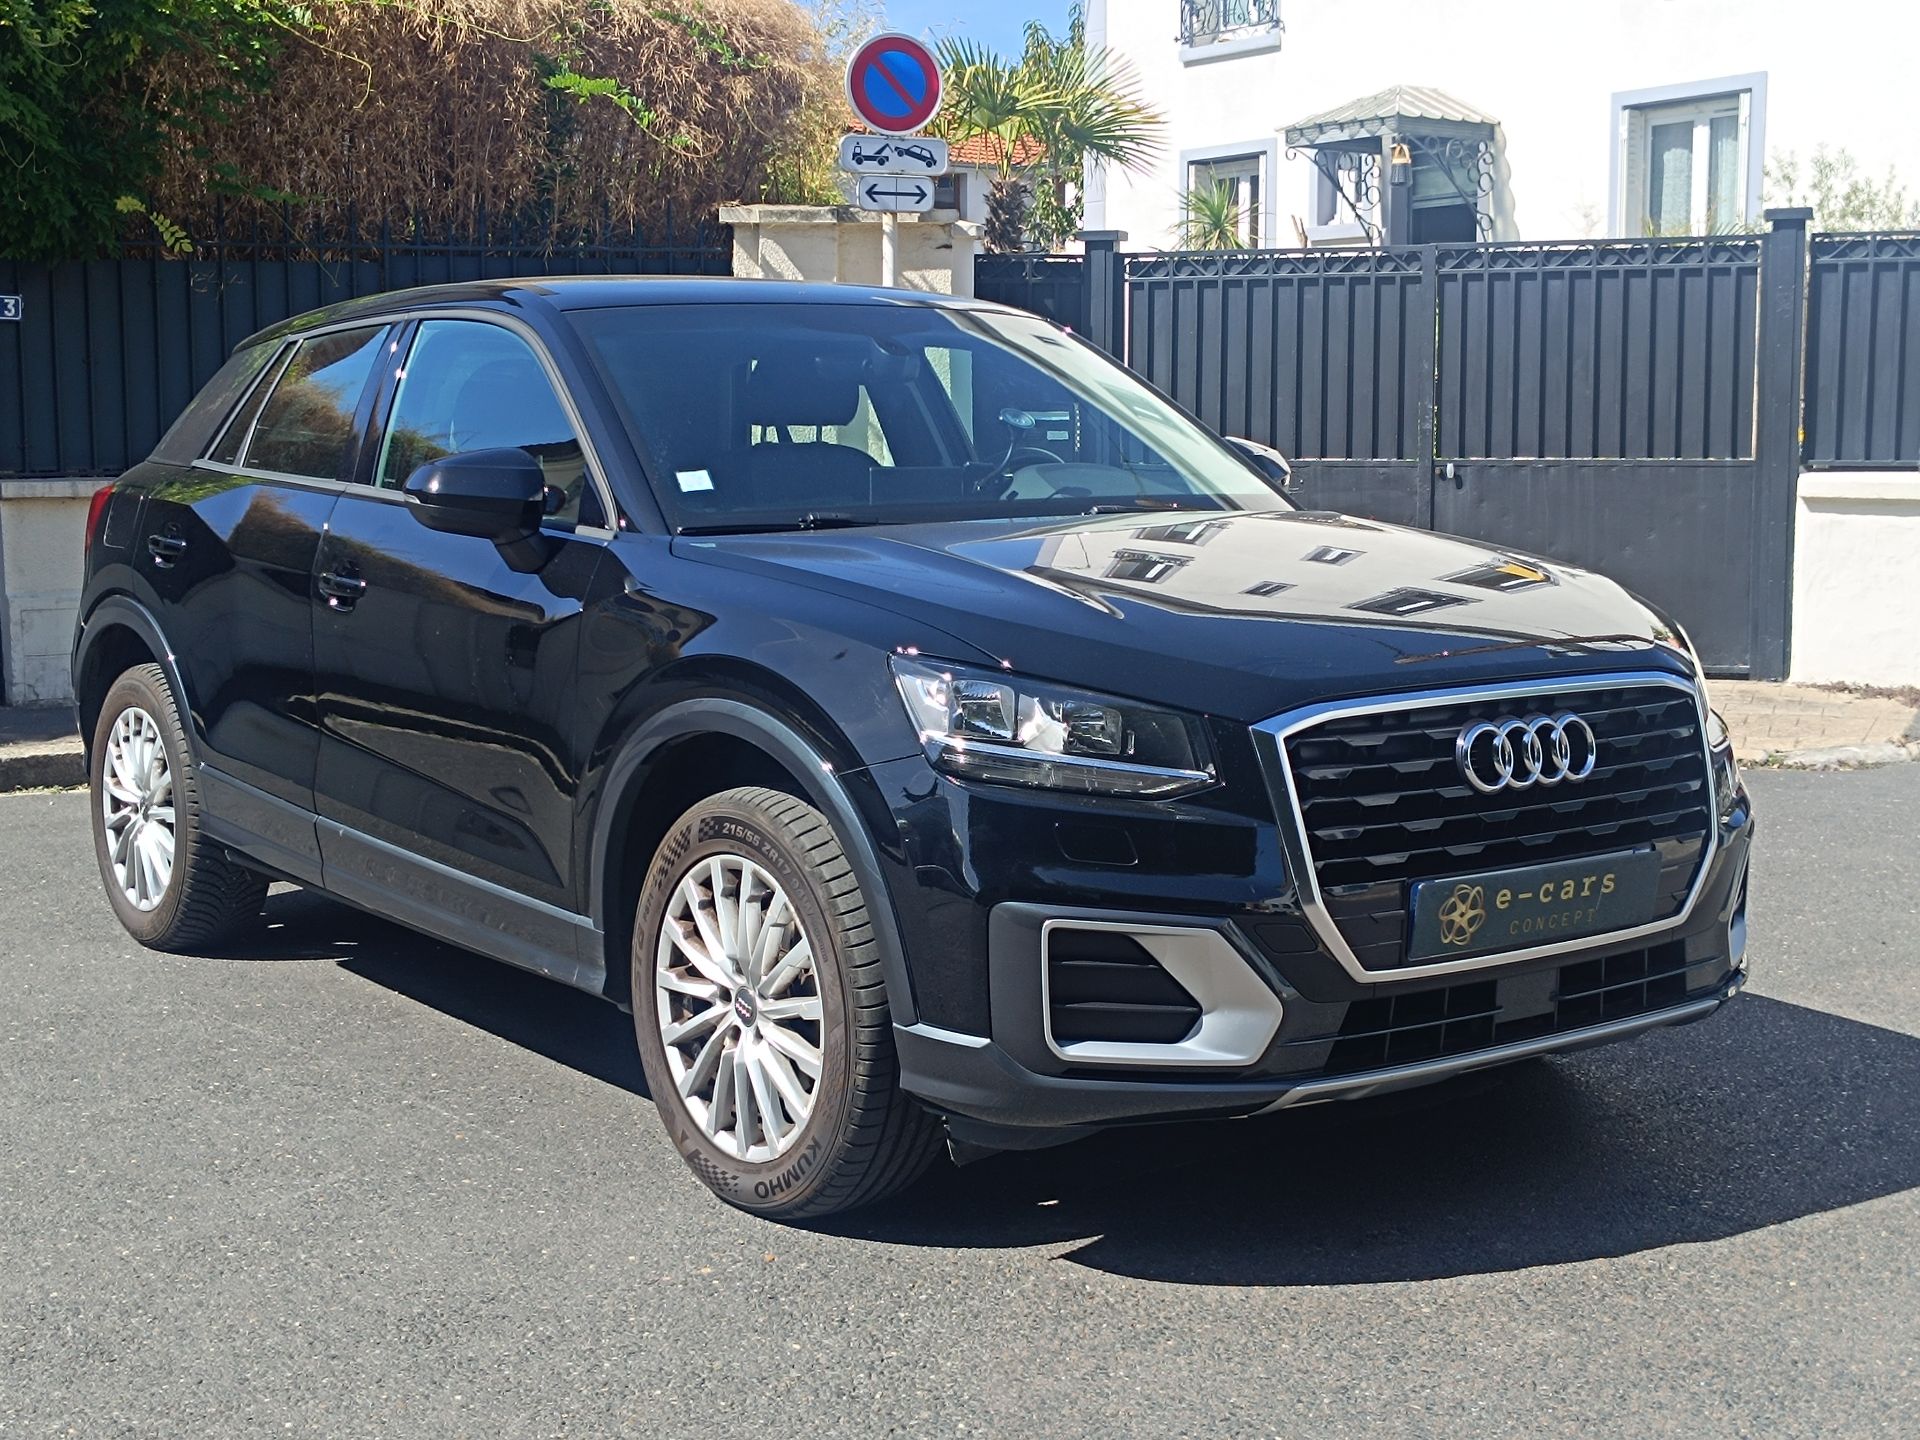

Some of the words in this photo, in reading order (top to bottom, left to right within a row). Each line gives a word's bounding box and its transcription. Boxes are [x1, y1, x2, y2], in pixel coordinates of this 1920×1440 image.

[4, 299, 15, 316] 3
[722, 822, 761, 847] 215/55
[761, 842, 792, 876] ZR17
[1495, 872, 1616, 909] e-cars
[1509, 908, 1597, 935] CONCEPT
[754, 1135, 823, 1199] KUMHO
